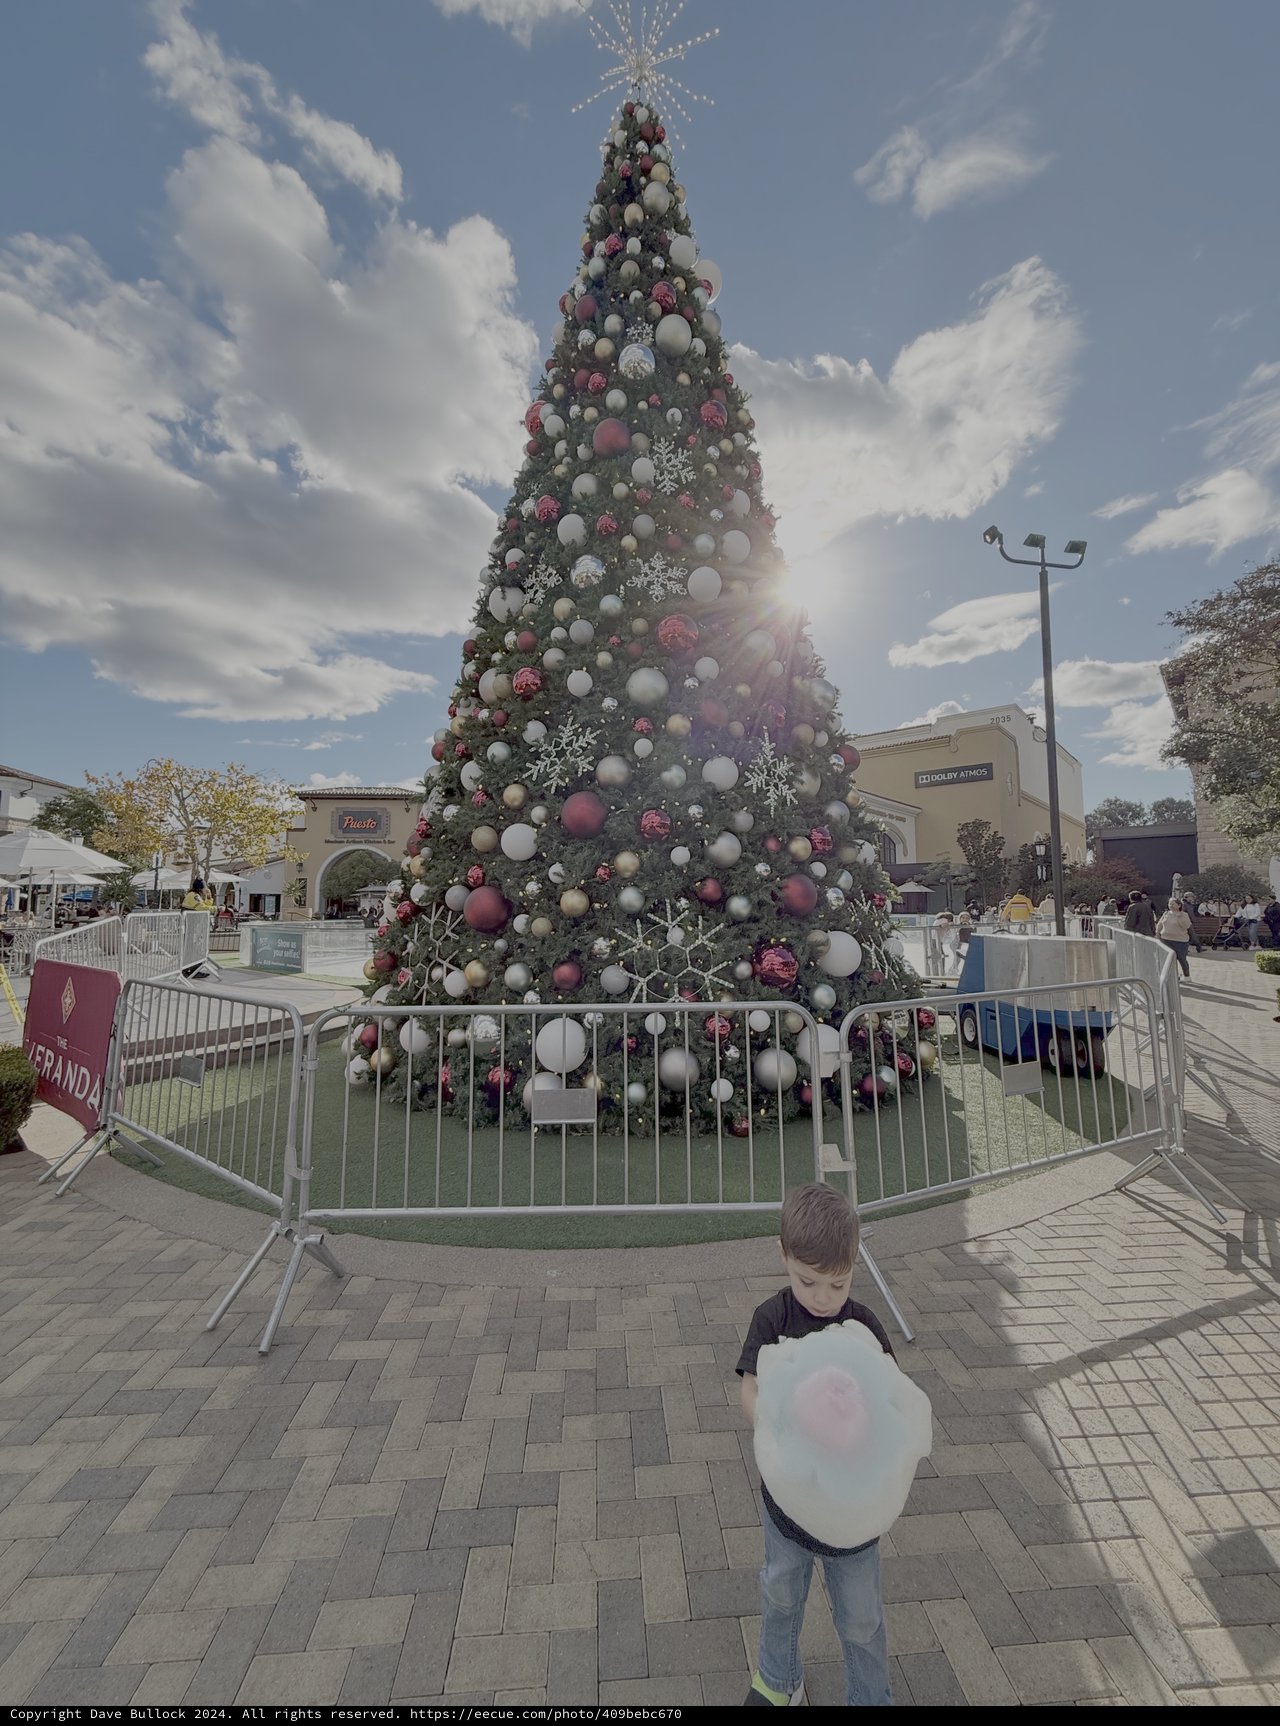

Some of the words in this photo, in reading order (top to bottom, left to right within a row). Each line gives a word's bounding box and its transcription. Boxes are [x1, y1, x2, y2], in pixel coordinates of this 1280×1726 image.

[990, 715, 1012, 725] 2035
[931, 772, 958, 782] DOLBY
[959, 768, 988, 778] ATMOS
[343, 816, 377, 829] Puesto
[277, 939, 290, 948] Show
[273, 949, 284, 957] your
[57, 1035, 68, 1050] THE
